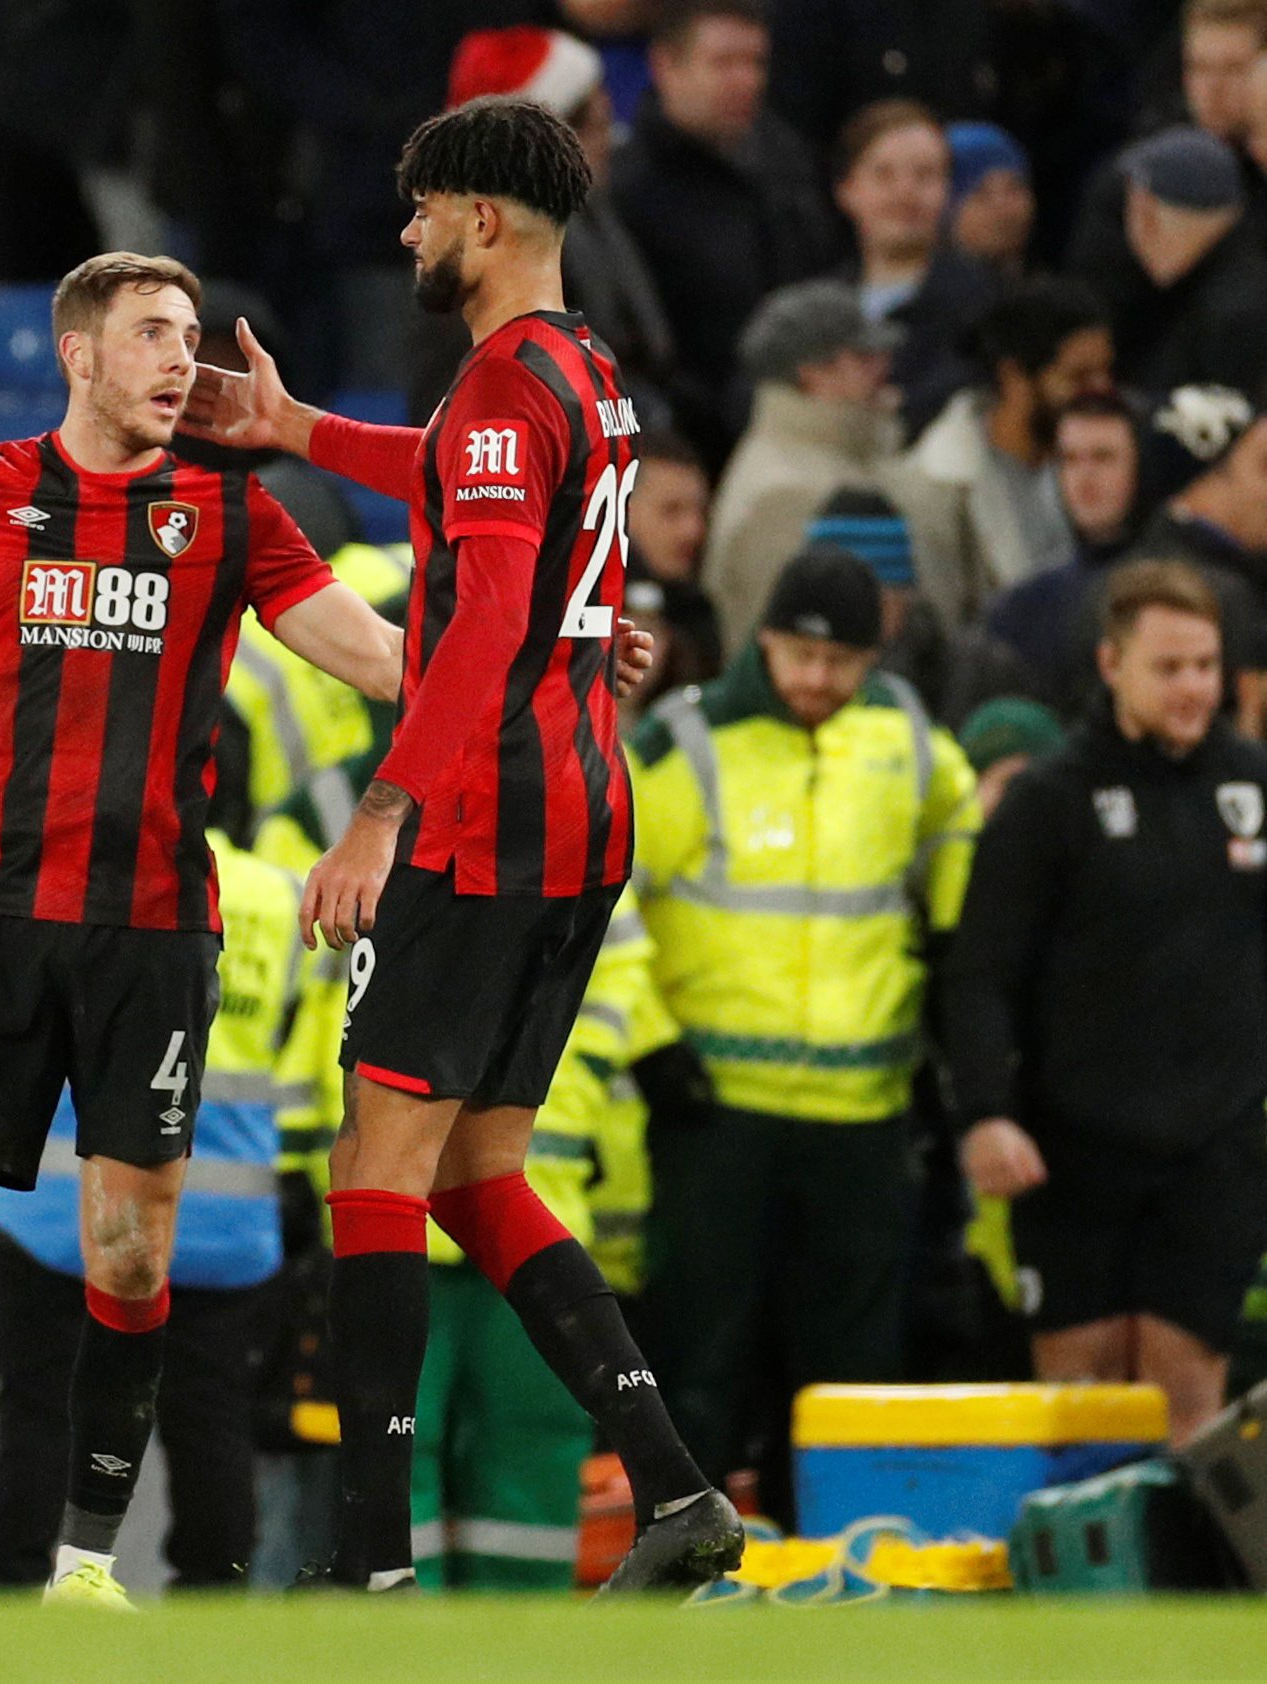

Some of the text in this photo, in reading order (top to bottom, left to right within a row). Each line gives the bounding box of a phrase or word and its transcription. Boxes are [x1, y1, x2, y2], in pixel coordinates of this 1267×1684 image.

[455, 485, 526, 502] MANSION
[20, 626, 126, 651] MANSION
[150, 1030, 189, 1106] 4
